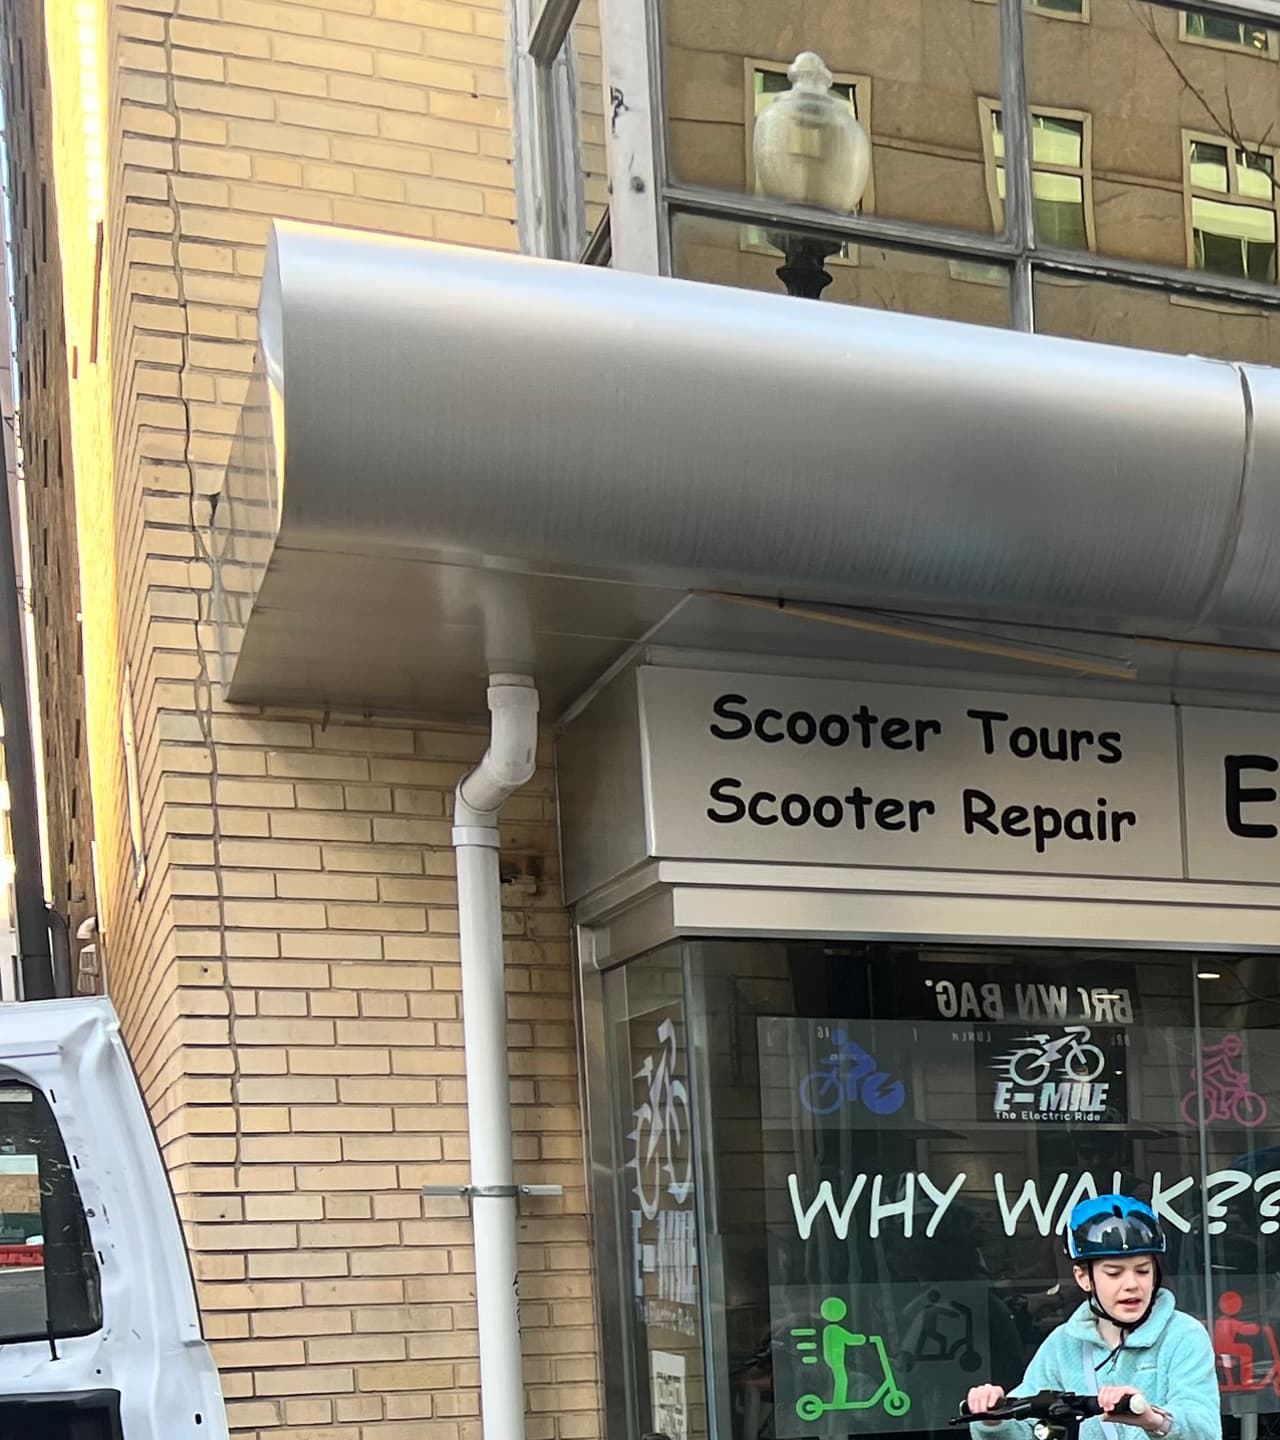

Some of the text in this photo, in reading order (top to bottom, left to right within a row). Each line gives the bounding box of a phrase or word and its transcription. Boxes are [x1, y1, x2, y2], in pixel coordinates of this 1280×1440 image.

[710, 693, 1123, 764] Scooter Tours
[706, 777, 1137, 853] Scooter Repair
[993, 1081, 1110, 1112] E-MILE
[1021, 1111, 1071, 1121] Electric
[1074, 1111, 1101, 1121] Ride
[788, 1172, 967, 1240] WHY
